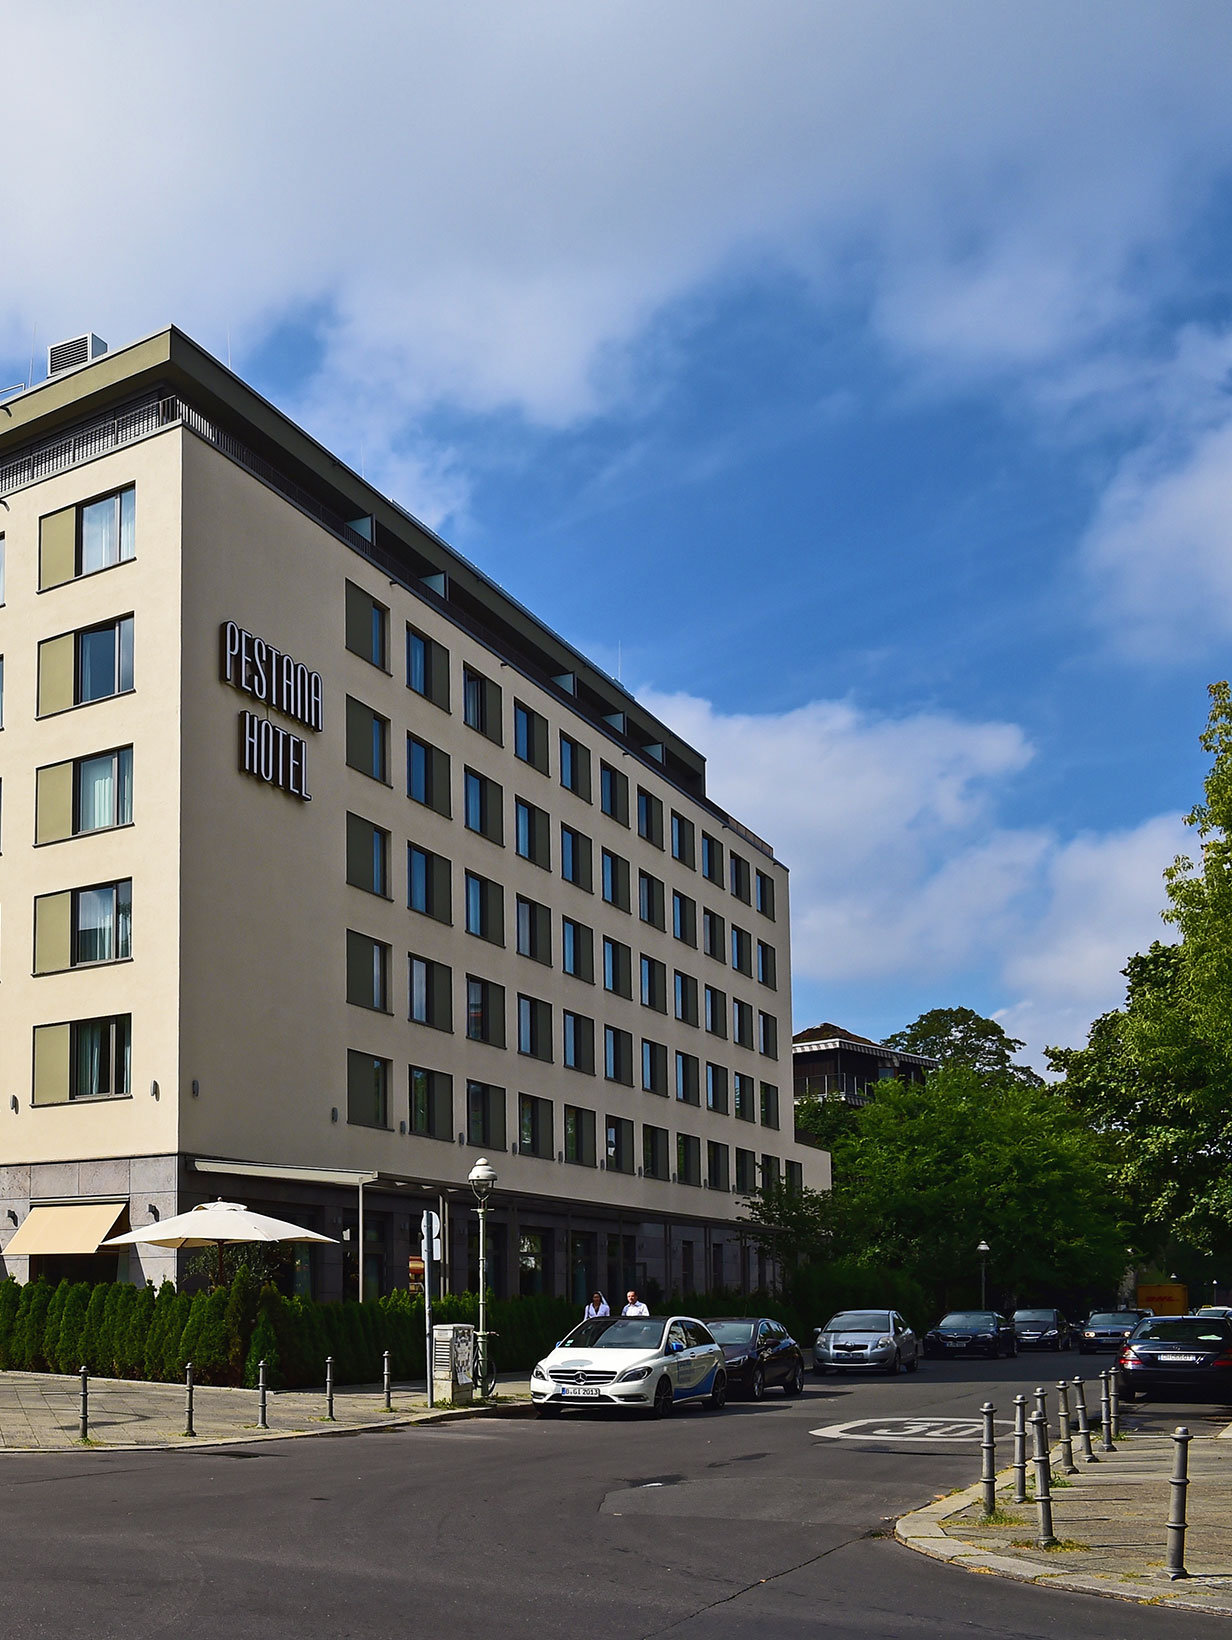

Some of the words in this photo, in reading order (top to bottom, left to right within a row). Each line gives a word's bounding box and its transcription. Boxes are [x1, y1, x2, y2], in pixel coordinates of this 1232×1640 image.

[222, 620, 323, 732] PESTANA
[239, 709, 312, 801] HOTEL
[873, 1421, 984, 1438] 30
